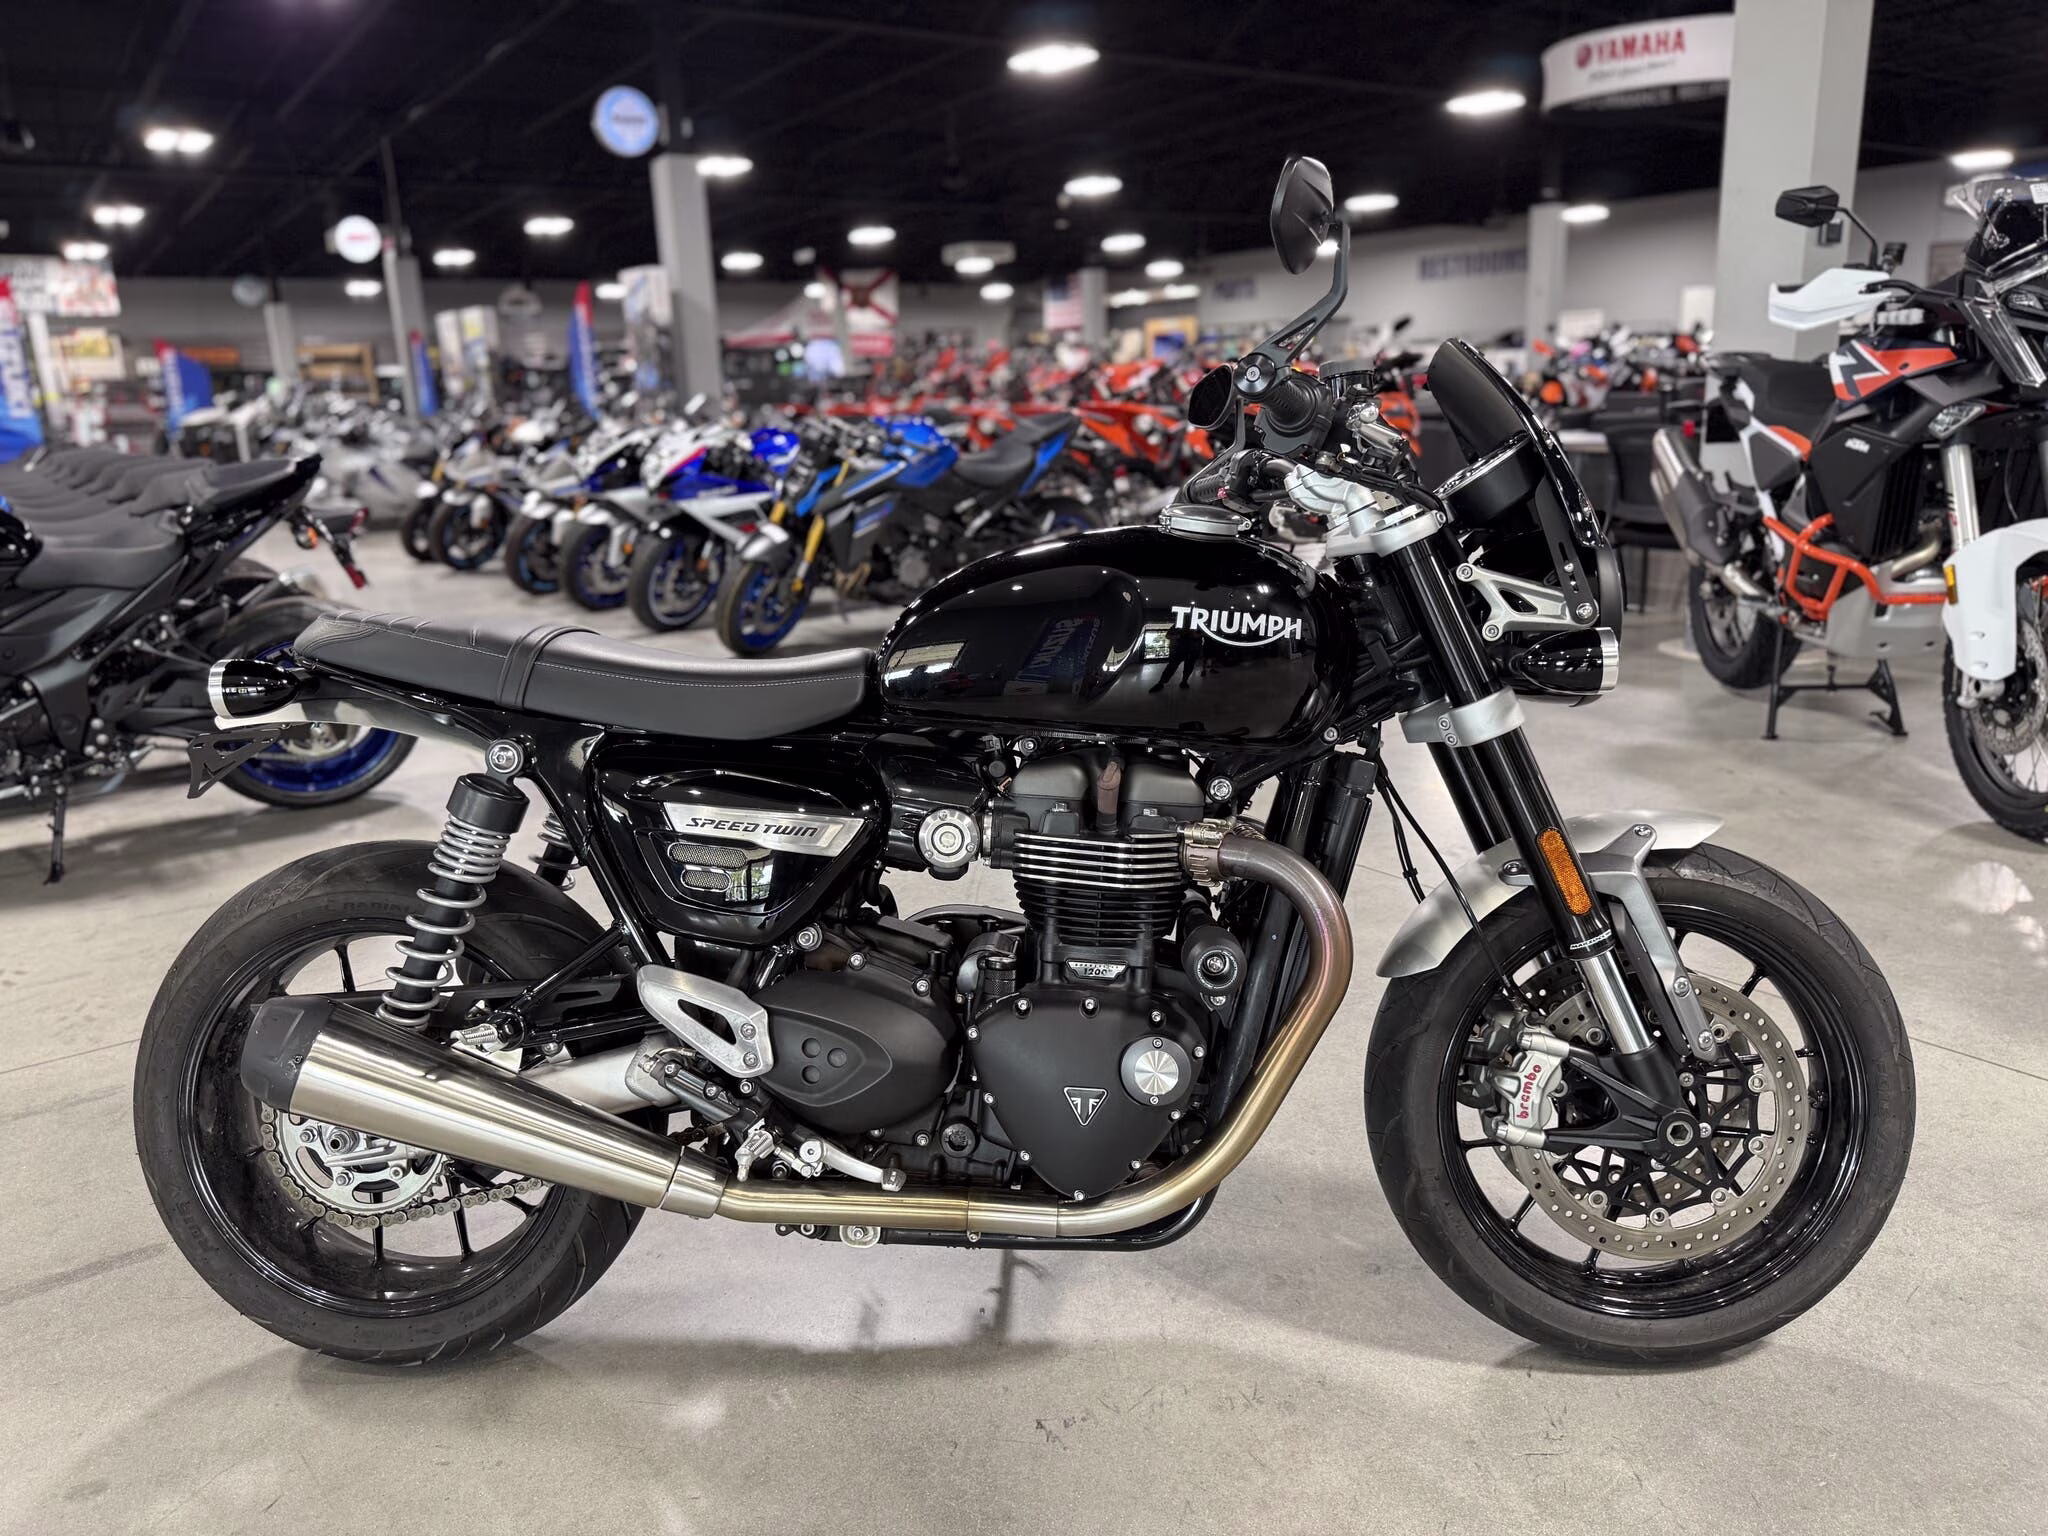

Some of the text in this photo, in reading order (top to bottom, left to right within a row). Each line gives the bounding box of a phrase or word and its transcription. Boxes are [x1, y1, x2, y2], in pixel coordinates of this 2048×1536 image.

[1596, 28, 1686, 65] YAMAHA
[1171, 605, 1302, 647] TRIUMPH
[686, 817, 818, 837] SPEED TWIN
[1516, 1064, 1542, 1119] brembo
